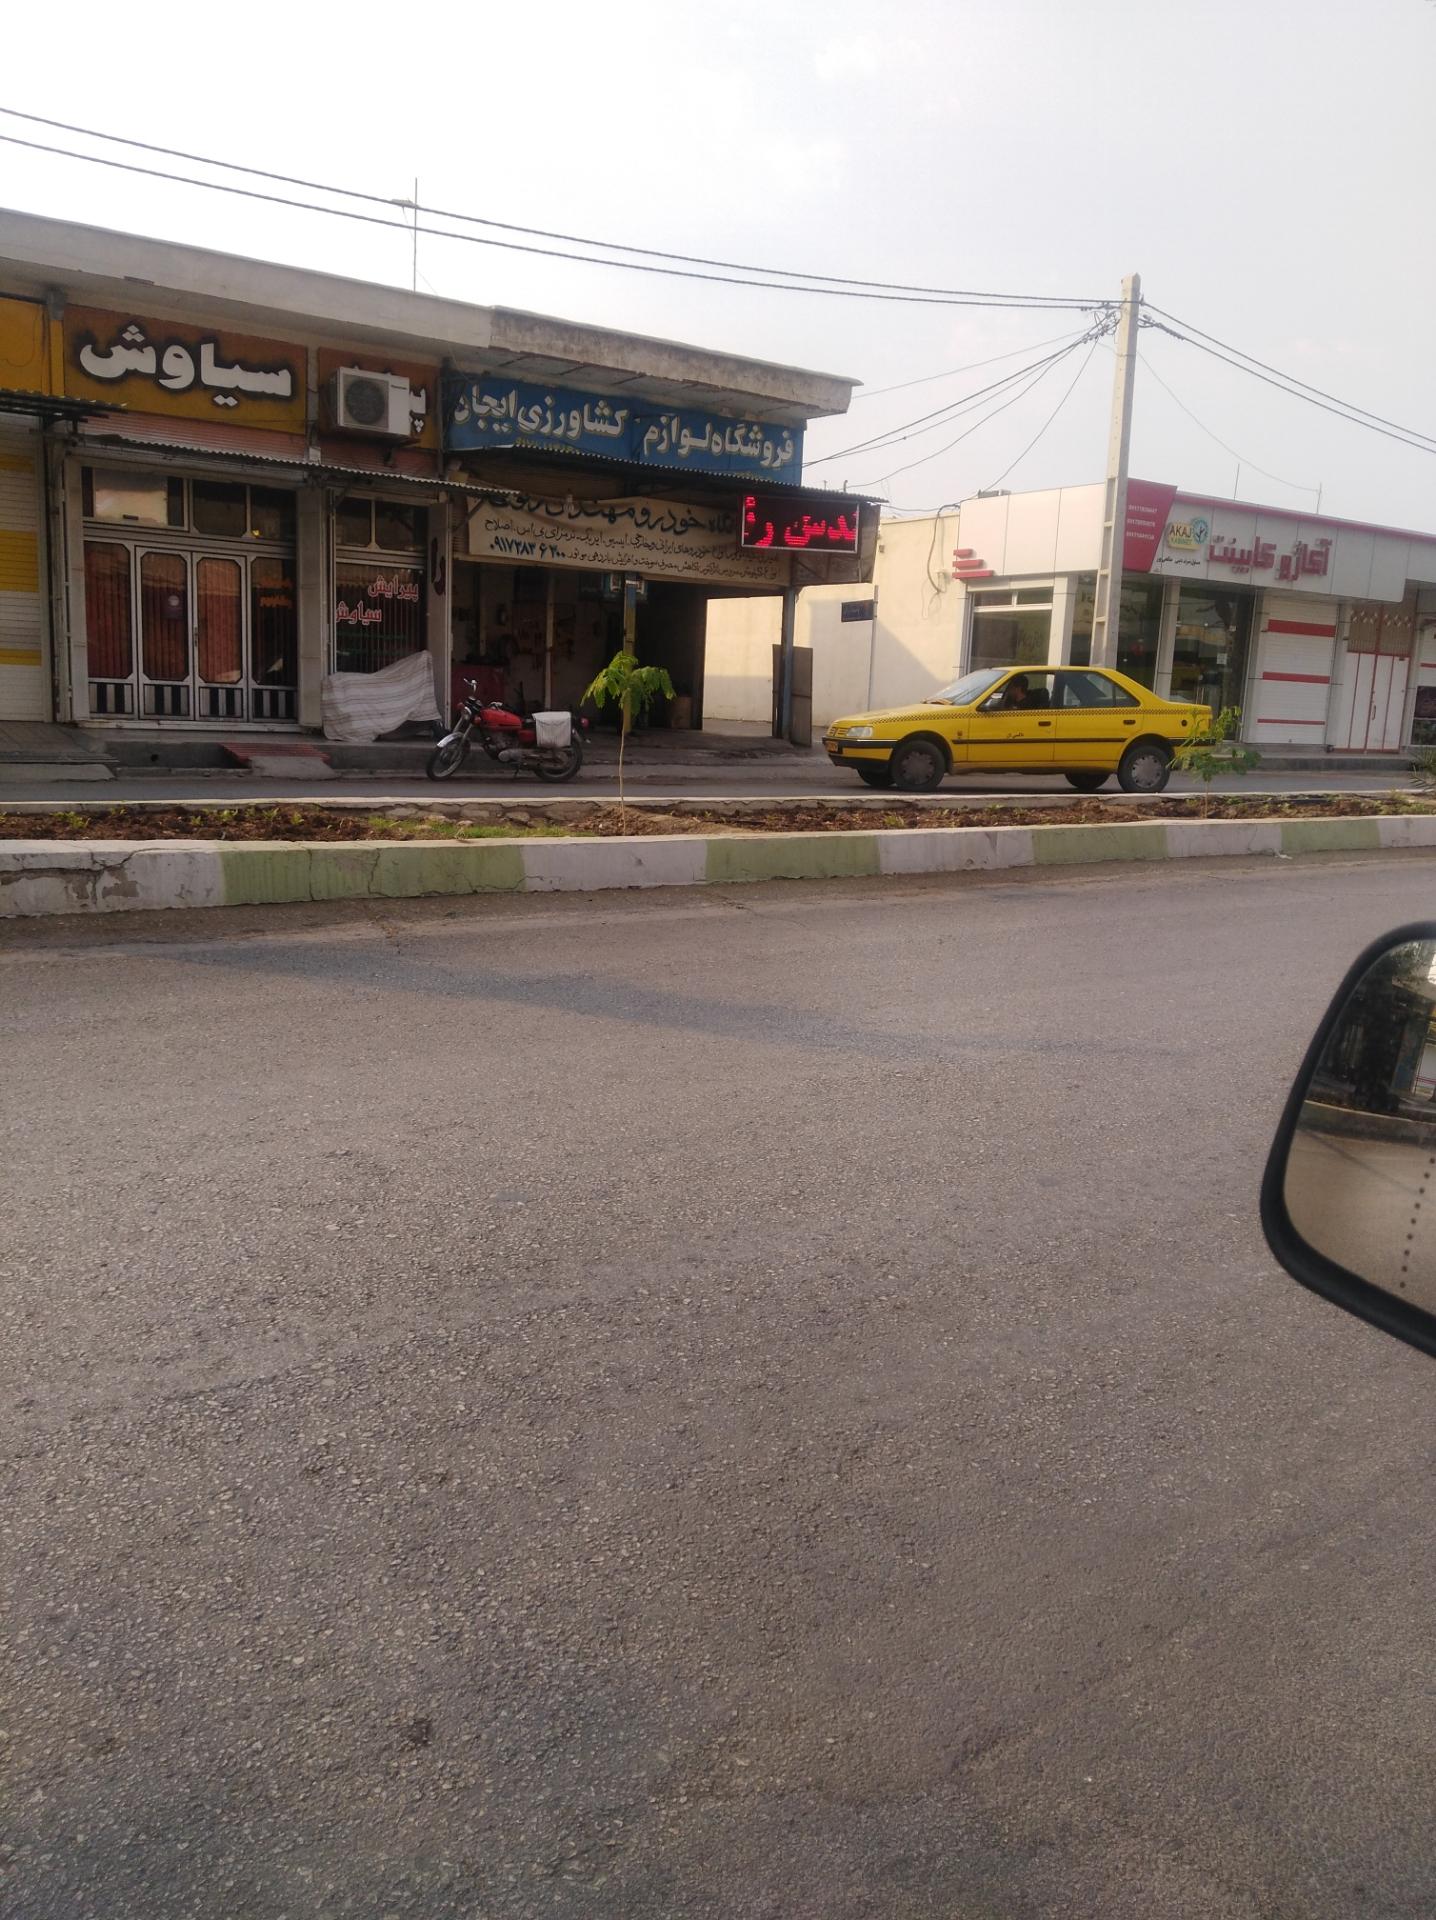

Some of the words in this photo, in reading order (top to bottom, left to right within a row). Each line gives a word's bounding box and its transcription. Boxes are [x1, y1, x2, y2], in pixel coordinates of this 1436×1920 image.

[79, 324, 292, 407] سیاوش
[517, 395, 629, 440] کشاورزی
[643, 415, 713, 458] لوازم
[710, 422, 795, 470] فروشگاه
[1208, 535, 1277, 575] کابینت
[368, 574, 419, 602] پیرایش
